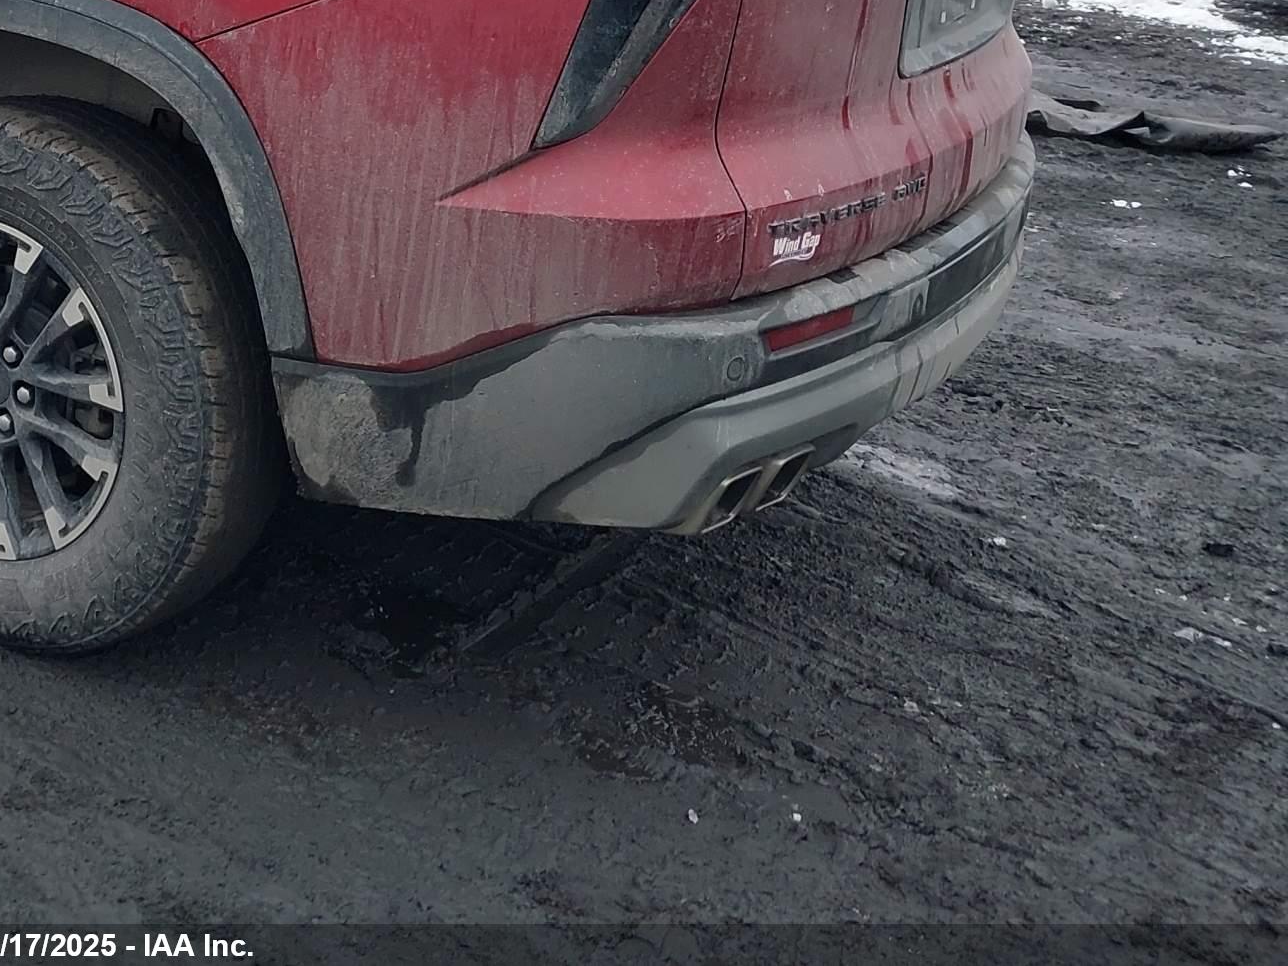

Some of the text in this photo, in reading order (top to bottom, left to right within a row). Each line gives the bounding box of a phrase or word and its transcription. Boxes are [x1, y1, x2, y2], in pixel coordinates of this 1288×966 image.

[767, 191, 887, 235] TRAVERSE
[773, 235, 801, 256] Wind
[801, 231, 821, 249] Gap
